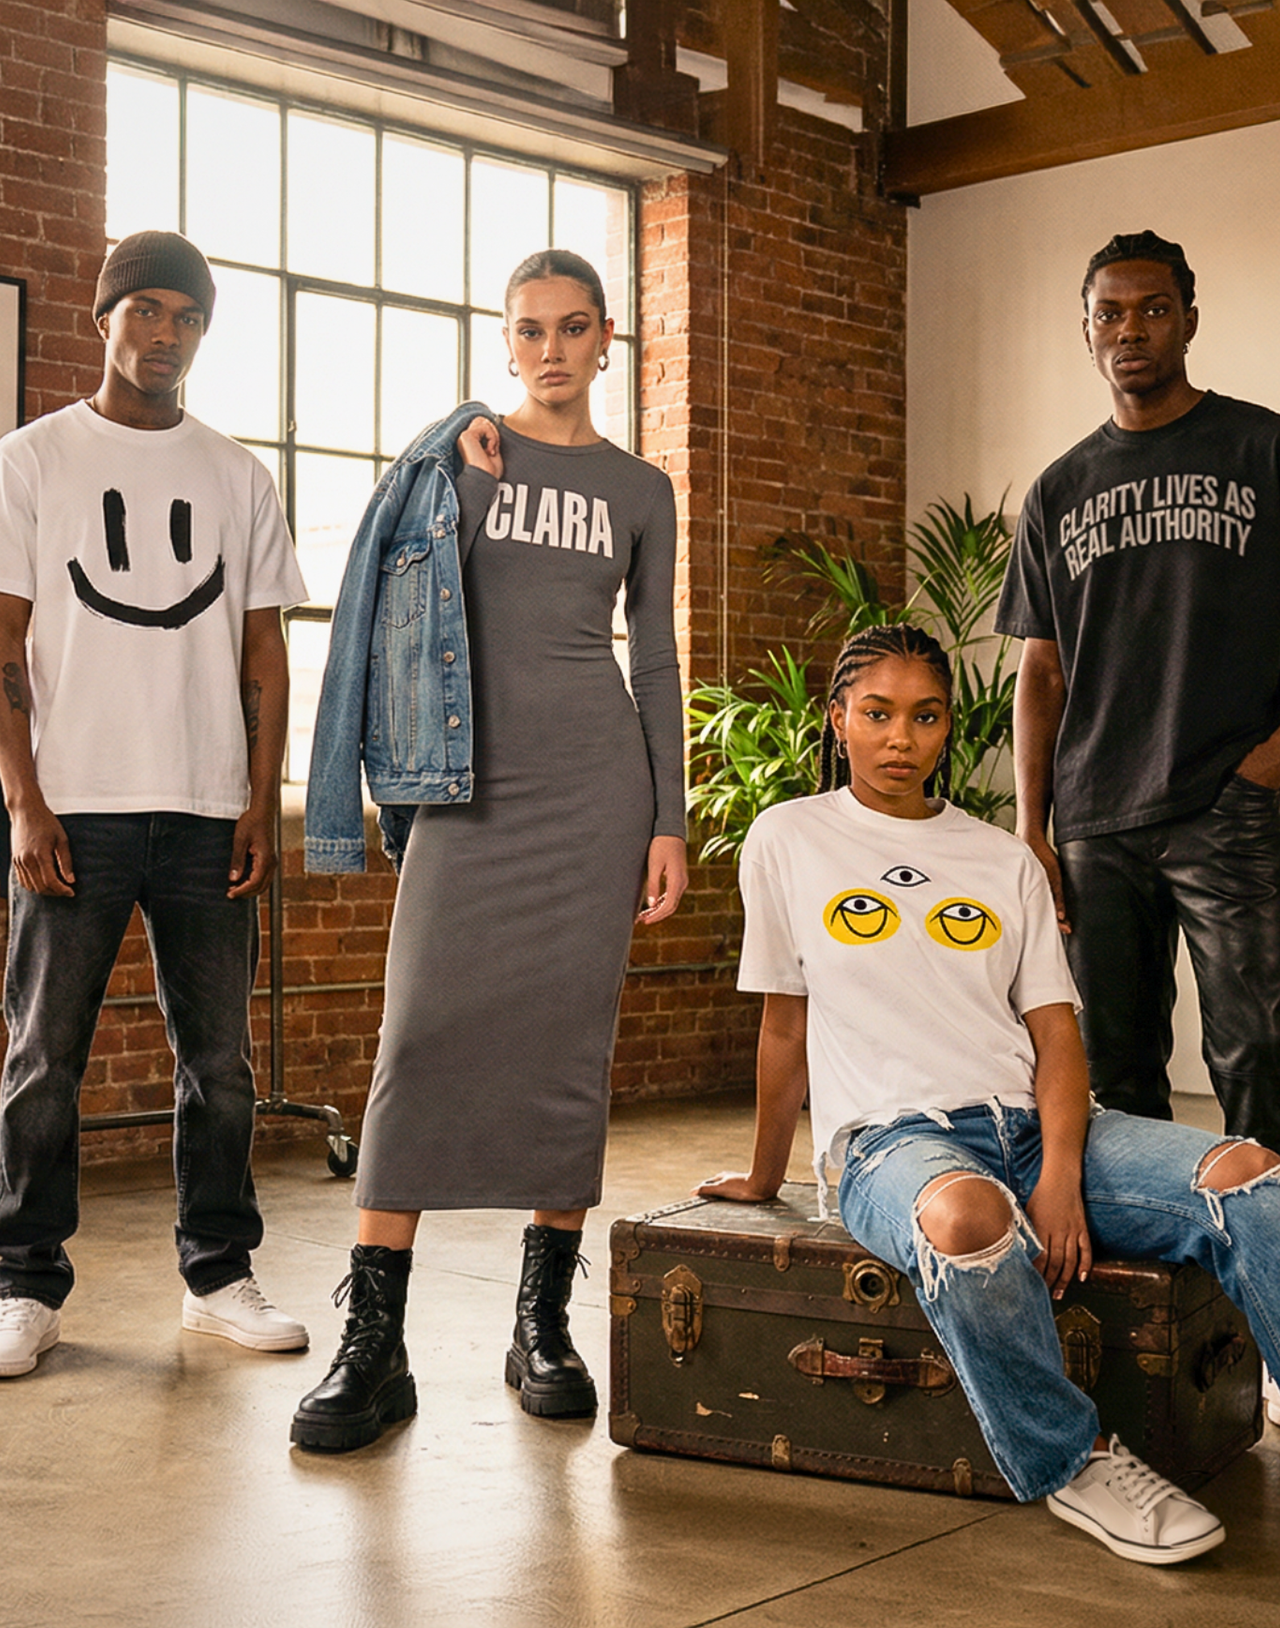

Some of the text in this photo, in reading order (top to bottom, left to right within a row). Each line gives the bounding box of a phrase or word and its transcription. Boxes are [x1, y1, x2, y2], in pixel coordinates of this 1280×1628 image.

[484, 481, 614, 559] CLARA
[1058, 473, 1257, 548] CLARITY LIVES AS
[1063, 507, 1253, 581] REAL AUTHORITY
